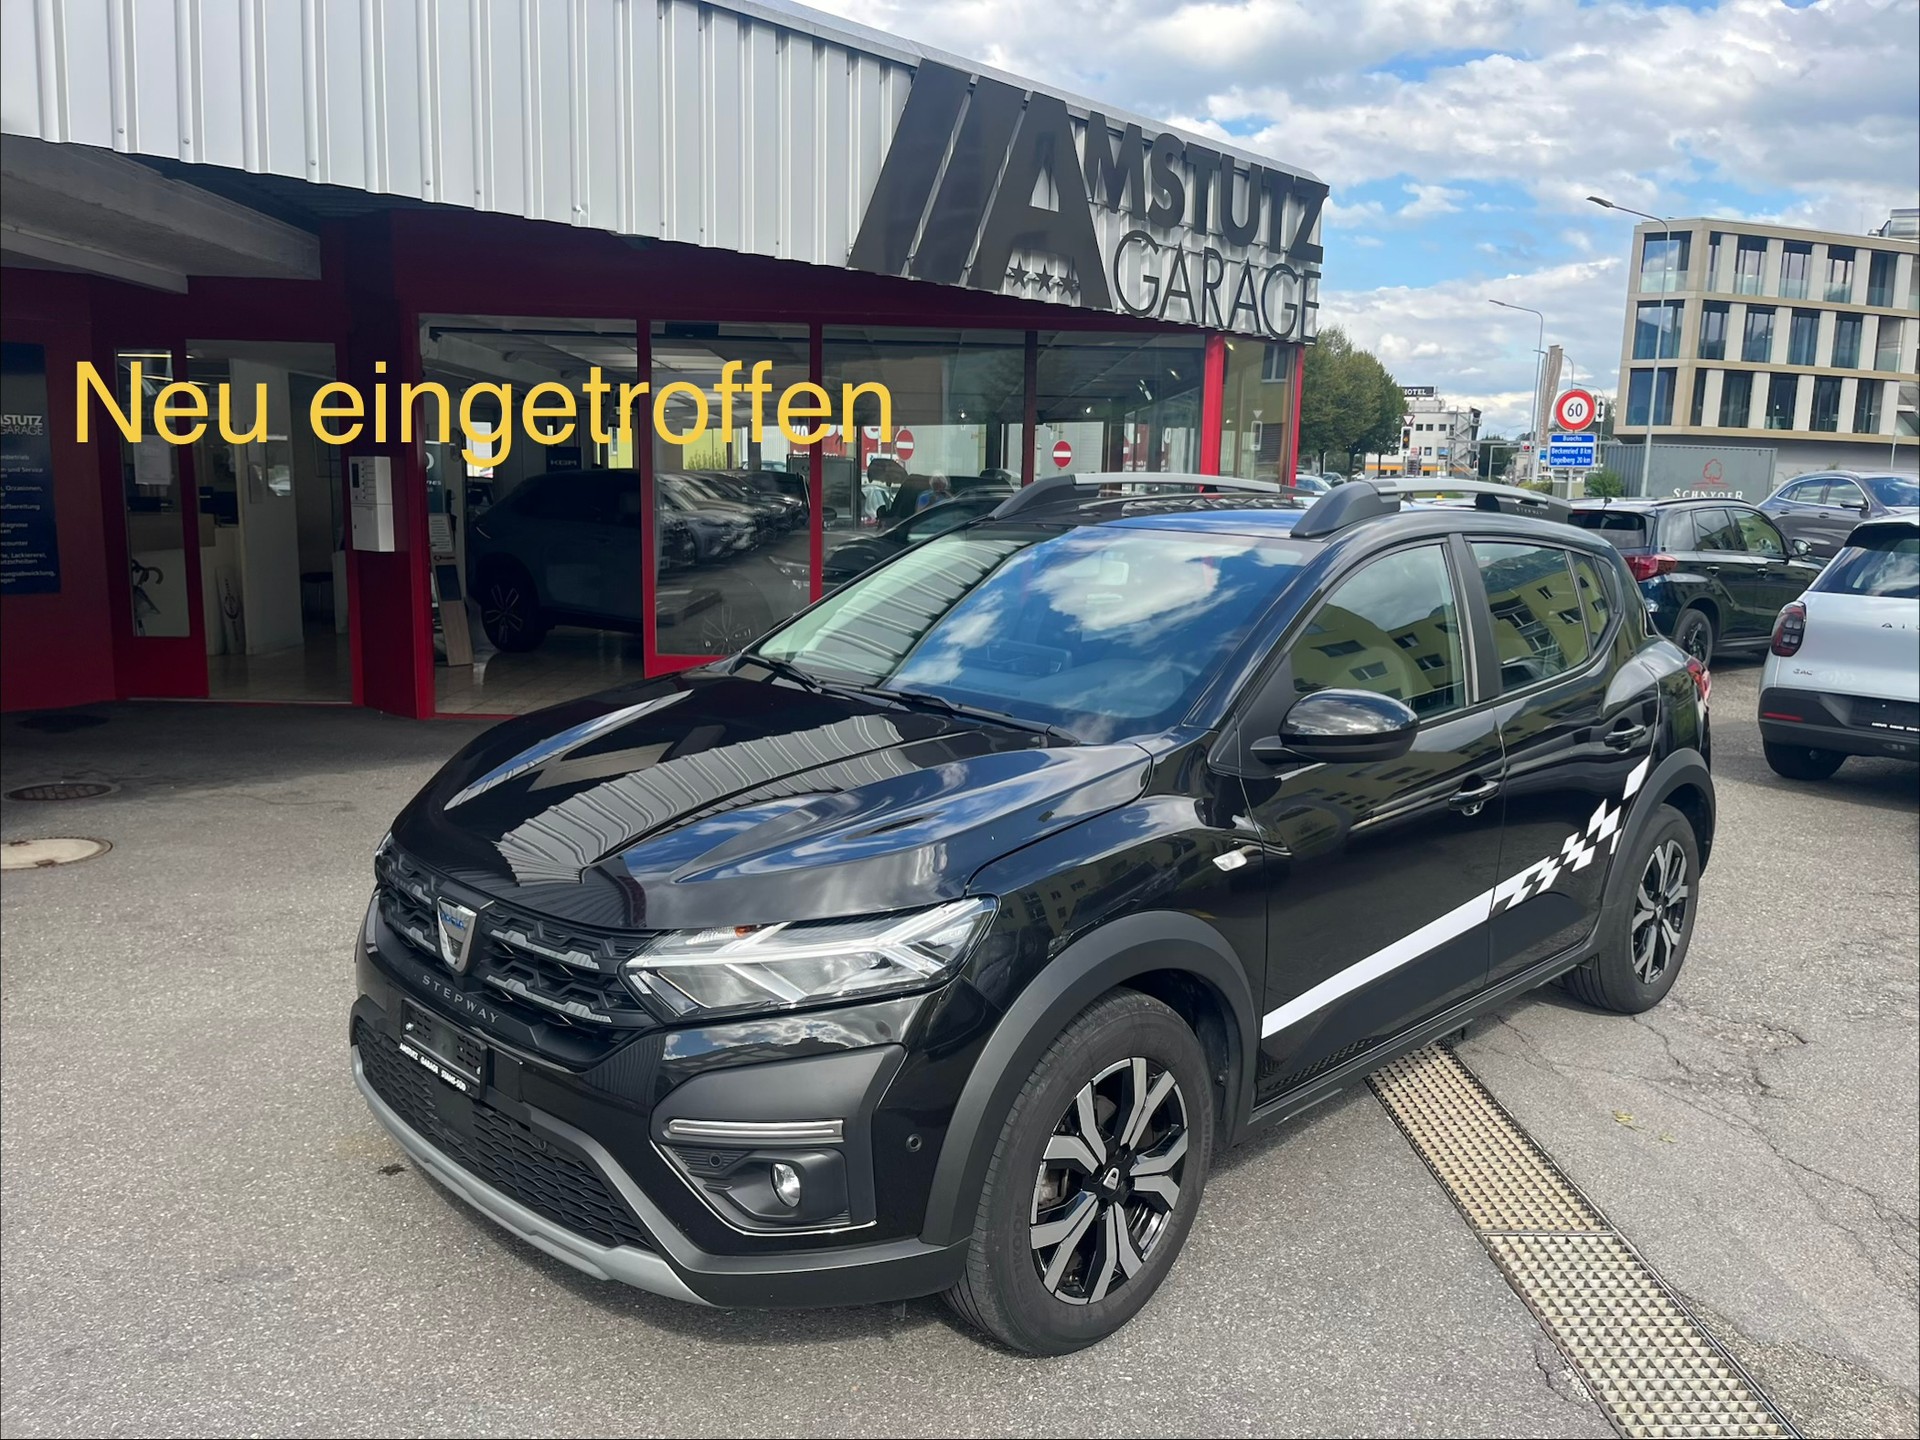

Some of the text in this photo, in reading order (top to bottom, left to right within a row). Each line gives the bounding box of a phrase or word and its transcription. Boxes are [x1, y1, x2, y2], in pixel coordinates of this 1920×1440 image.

[965, 91, 1329, 308] AMSTUTZ
[1113, 230, 1322, 346] GARAGE
[1567, 402, 1583, 417] 60
[422, 974, 499, 1023] STEPWAY
